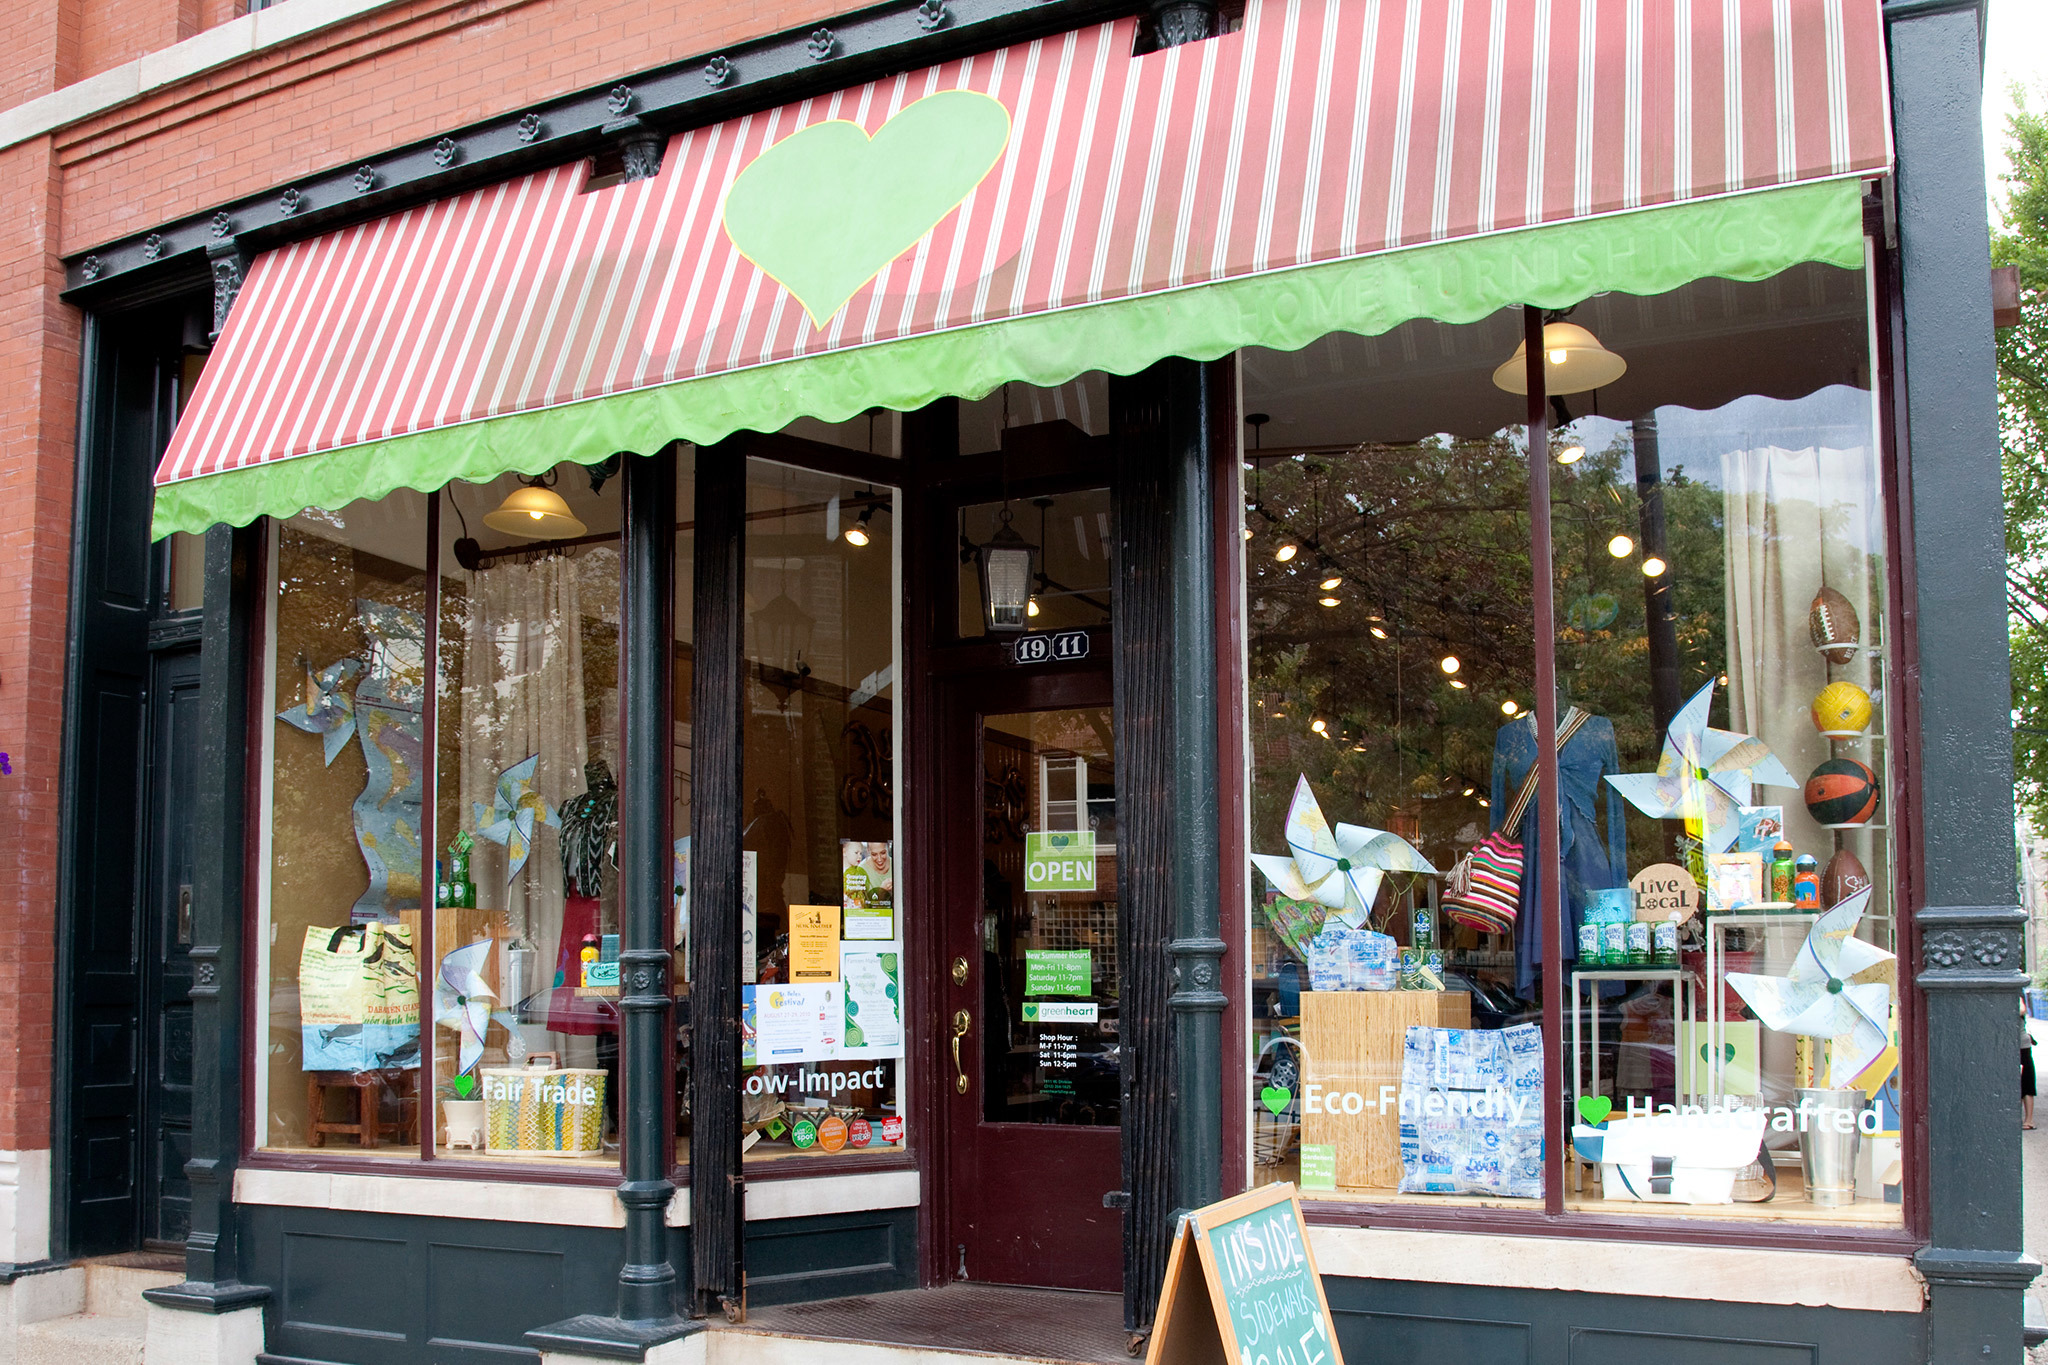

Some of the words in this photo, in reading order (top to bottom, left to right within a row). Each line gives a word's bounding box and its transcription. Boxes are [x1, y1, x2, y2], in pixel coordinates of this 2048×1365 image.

[1235, 281, 1377, 334] HOME
[1028, 860, 1092, 882] OPEN
[1031, 984, 1055, 992] Sunday
[1057, 984, 1081, 992] 11-6pm
[1042, 1006, 1094, 1017] greenheart
[1040, 1034, 1056, 1042] Shop
[1053, 1043, 1077, 1051] 11-7pm
[1053, 1052, 1077, 1060] 11-6pm
[1053, 1060, 1077, 1068] 12-5pm
[742, 1066, 884, 1097] ow-Impact
[482, 1076, 524, 1101] Fair
[531, 1078, 596, 1105] Trade
[1305, 1084, 1528, 1127] Eco-Friendly
[1627, 1096, 1883, 1134] Handcrafted
[797, 1133, 813, 1142] spot
[1221, 1212, 1304, 1287] INSIDE
